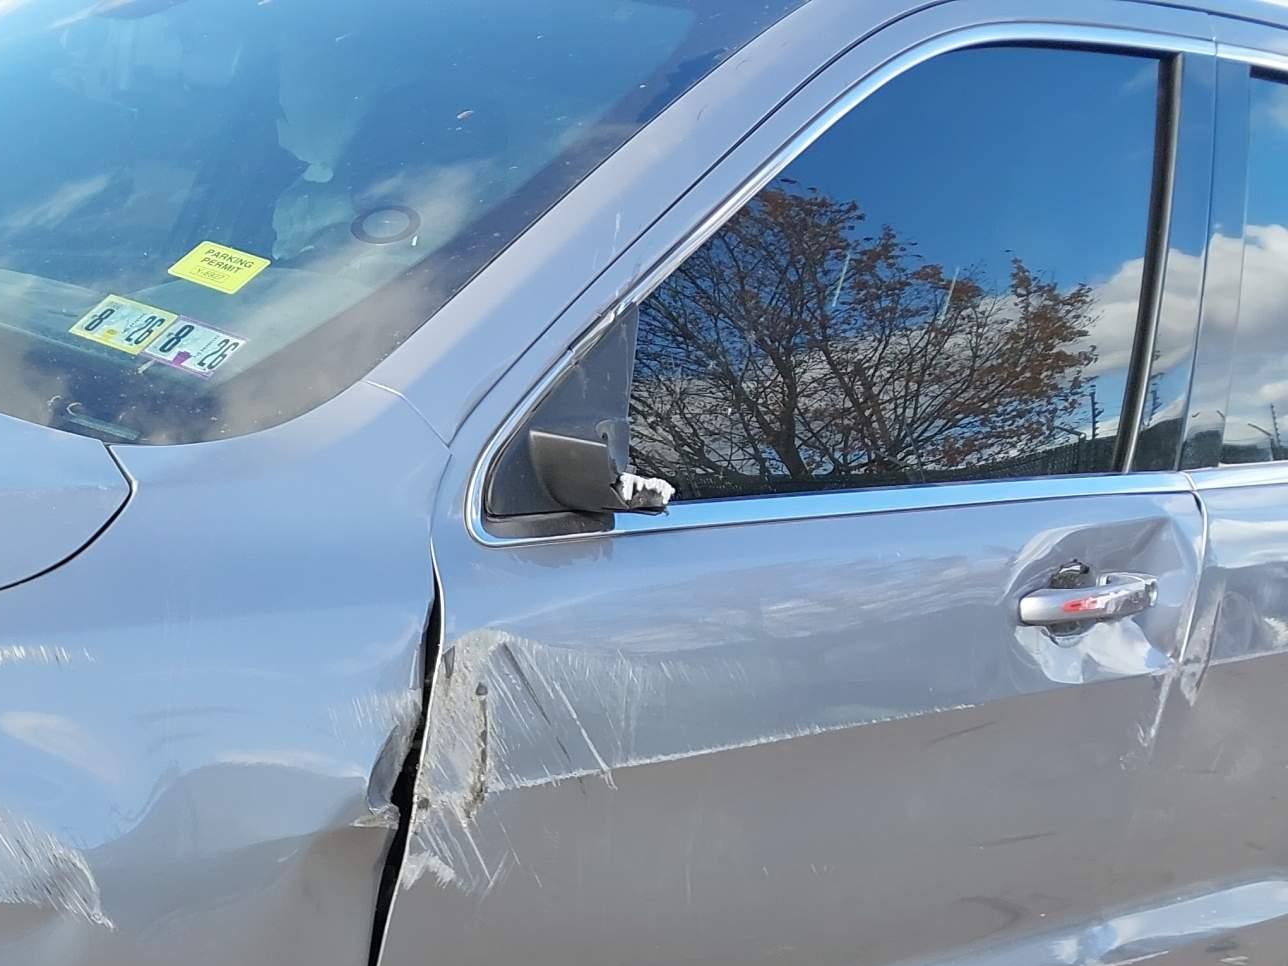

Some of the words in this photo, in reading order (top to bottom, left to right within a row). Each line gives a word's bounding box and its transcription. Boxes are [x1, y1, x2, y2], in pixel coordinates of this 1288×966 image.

[199, 257, 244, 274] PERMIT
[205, 248, 255, 269] PARKING
[84, 308, 115, 331] 8
[126, 315, 165, 345] 26
[160, 325, 194, 352] 8
[197, 338, 240, 369] 26
